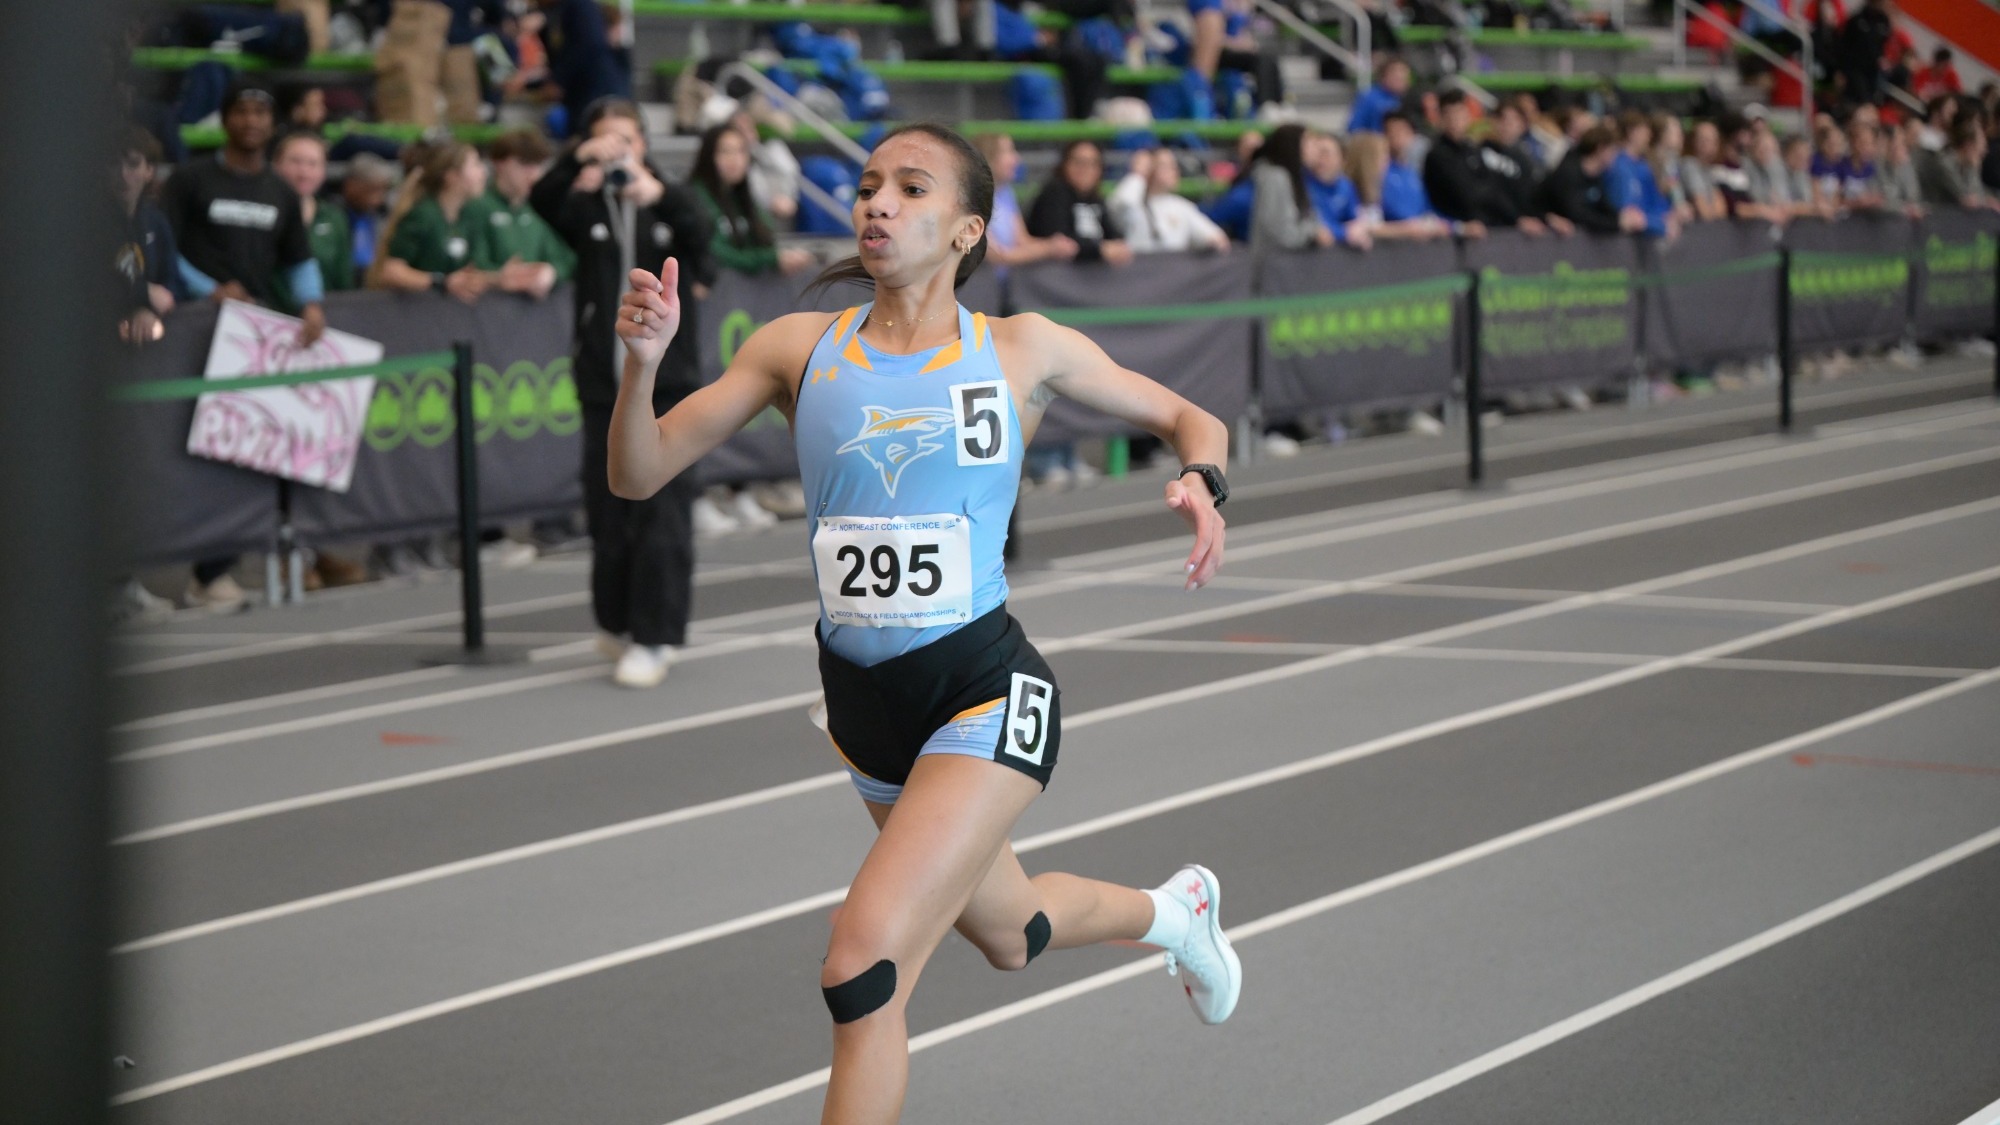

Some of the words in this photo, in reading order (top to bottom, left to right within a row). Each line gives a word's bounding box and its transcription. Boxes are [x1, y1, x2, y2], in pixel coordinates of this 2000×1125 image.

[961, 386, 1002, 459] 5
[839, 523, 879, 532] NORTHEAST
[881, 521, 940, 531] CONFERENCE
[836, 543, 943, 598] 295
[900, 608, 957, 619] CHAMPIONSHIPS
[1013, 680, 1047, 754] 5
